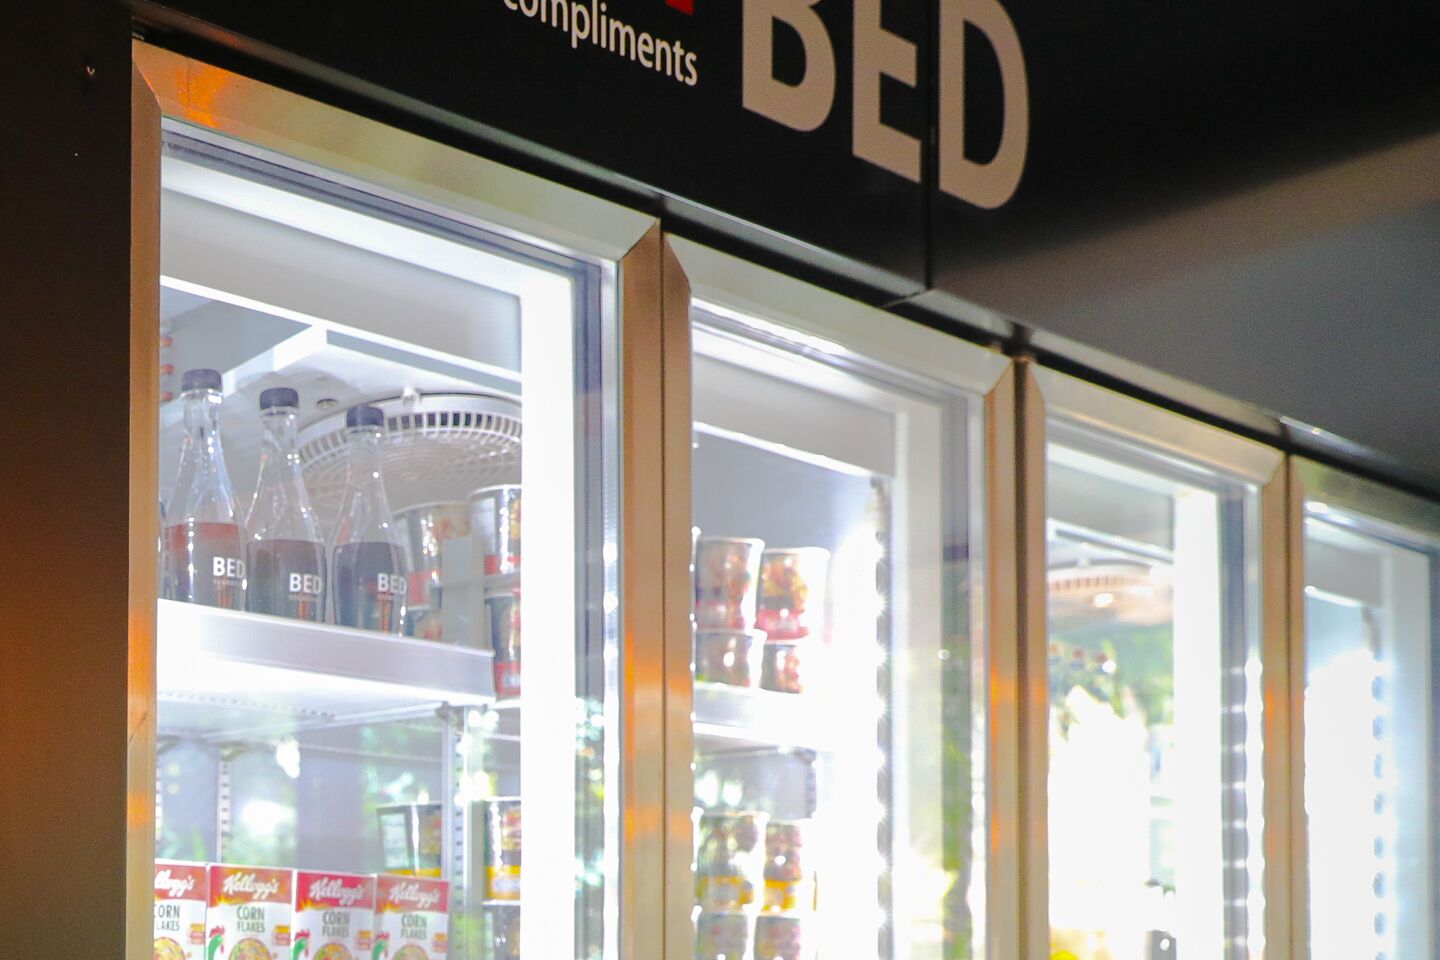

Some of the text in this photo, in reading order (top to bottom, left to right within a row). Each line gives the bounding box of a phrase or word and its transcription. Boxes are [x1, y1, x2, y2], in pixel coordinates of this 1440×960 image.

[742, 0, 1030, 209] BED
[213, 556, 246, 578] BED
[289, 572, 322, 595] BED
[377, 572, 407, 596] BED
[155, 904, 181, 919] ORN
[237, 905, 265, 921] CORN
